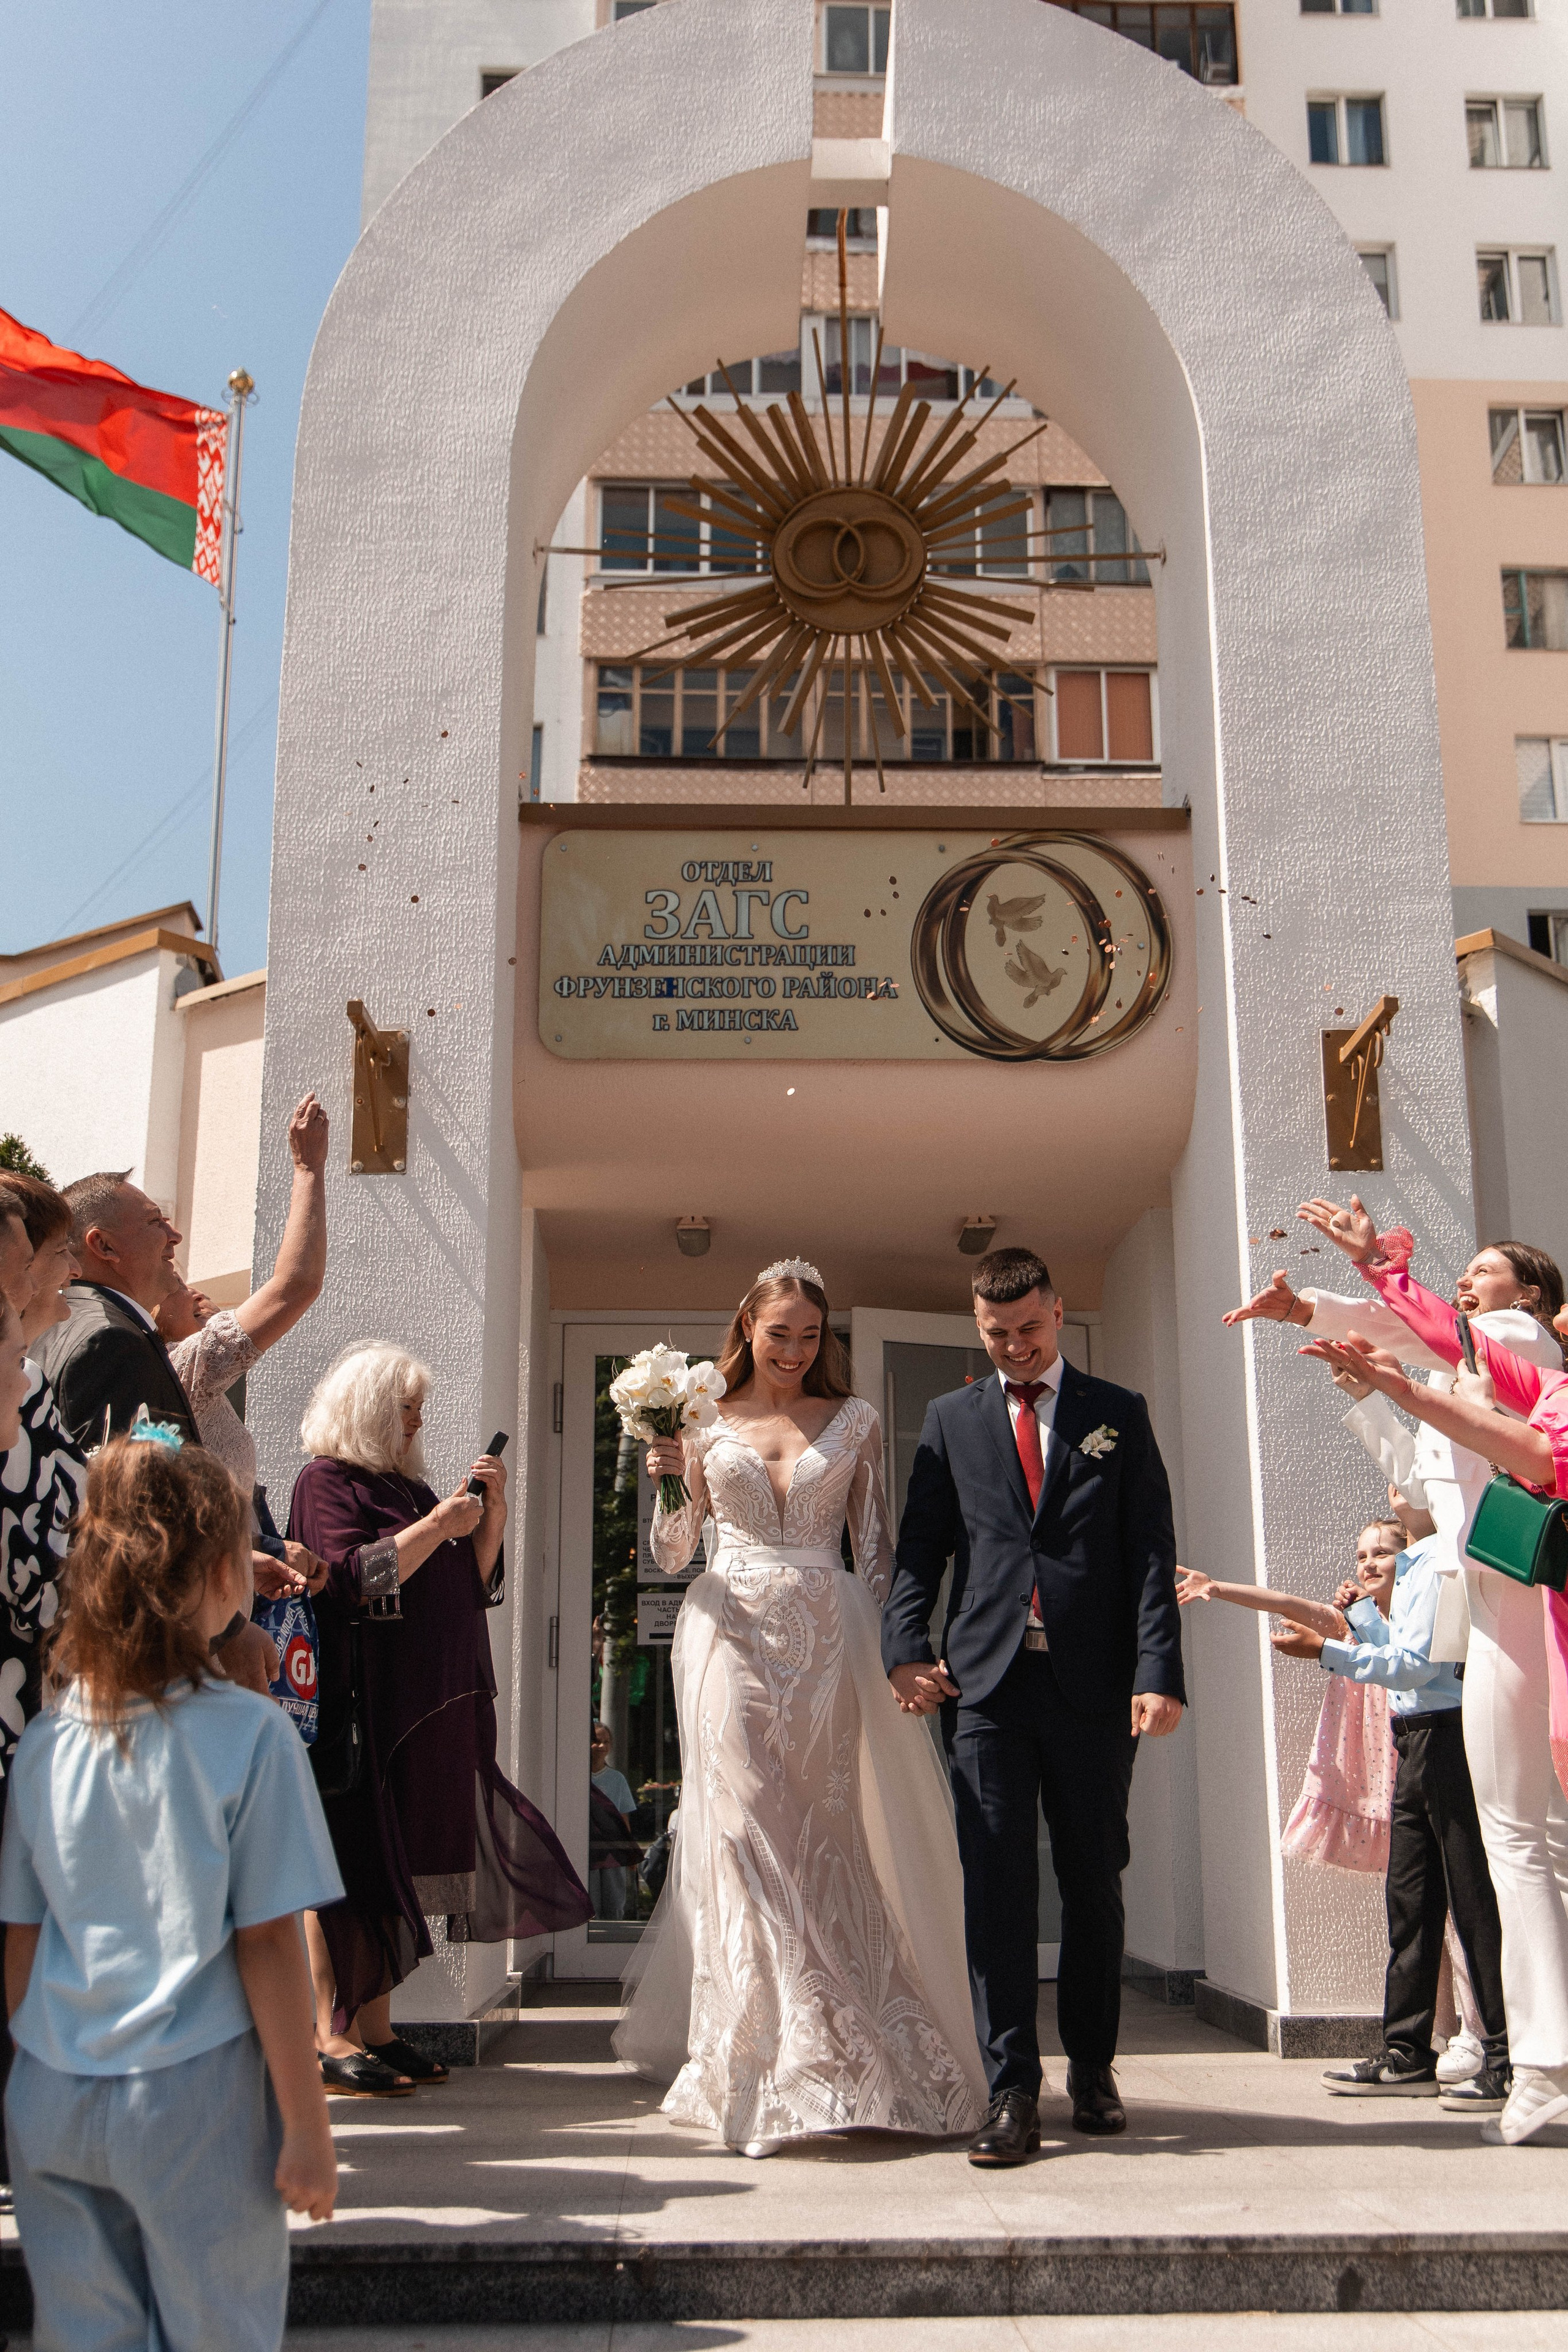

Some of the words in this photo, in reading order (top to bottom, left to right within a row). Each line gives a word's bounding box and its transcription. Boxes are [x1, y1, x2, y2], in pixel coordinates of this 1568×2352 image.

[681, 861, 772, 886] ОТДЕЛ
[644, 889, 809, 940] ЗАГС
[597, 944, 855, 971] АДМИНИСТРАЦИИ
[554, 976, 776, 998] ФРУНЗЕНСКОГО
[782, 971, 899, 999] РАЙОНА
[676, 1009, 798, 1031] МИНСКА
